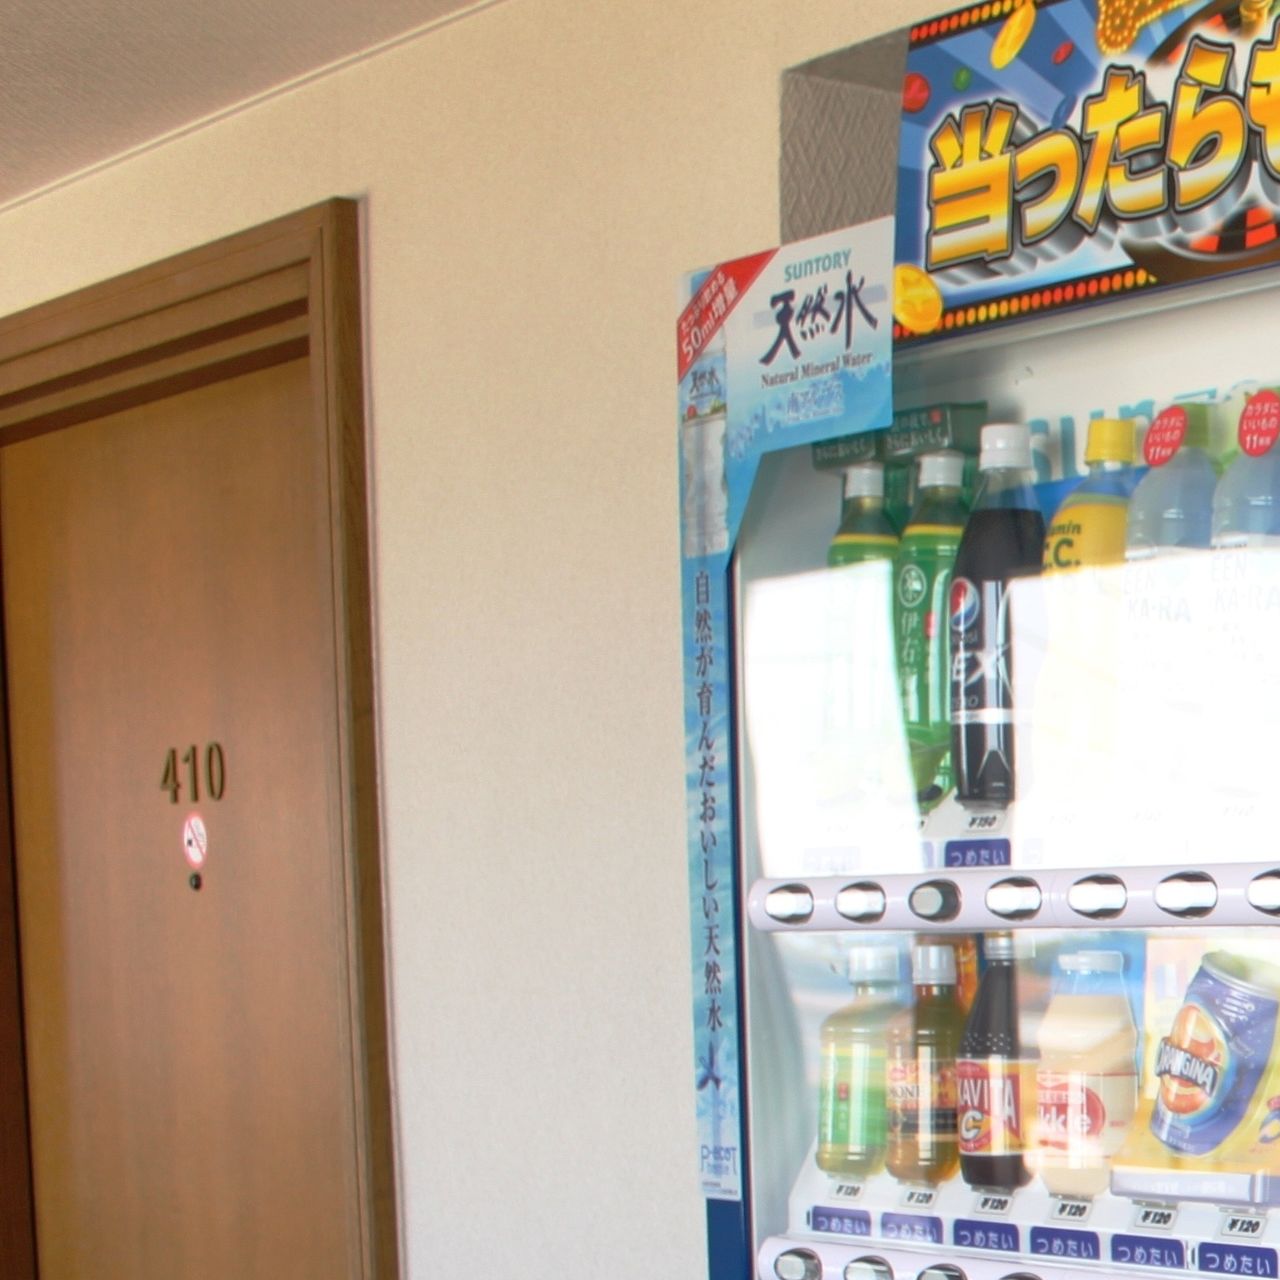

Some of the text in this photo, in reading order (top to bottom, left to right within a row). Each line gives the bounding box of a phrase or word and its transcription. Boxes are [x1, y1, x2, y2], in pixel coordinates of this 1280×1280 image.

[784, 250, 852, 283] SUNTORY
[759, 269, 878, 366] 天然水
[760, 352, 873, 389] Natural Mineral Water
[160, 740, 226, 804] 410
[694, 571, 723, 1033] 自然が育んだおいしい天然水
[951, 849, 1005, 867] つめたい
[960, 1110, 984, 1141] C
[836, 1185, 861, 1198] ¥120
[906, 1191, 933, 1204] ¥120
[980, 1197, 1009, 1211] ¥120
[1058, 1203, 1087, 1218] ¥120
[816, 1217, 867, 1236] つめたい
[1140, 1211, 1172, 1225] ¥120
[1226, 1218, 1260, 1235] ¥120
[885, 1222, 937, 1242] つめたい
[958, 1228, 1015, 1249] つめたい
[1035, 1234, 1094, 1258] つめたい
[1117, 1242, 1179, 1267] つめたい
[1204, 1248, 1272, 1275] つめたい
